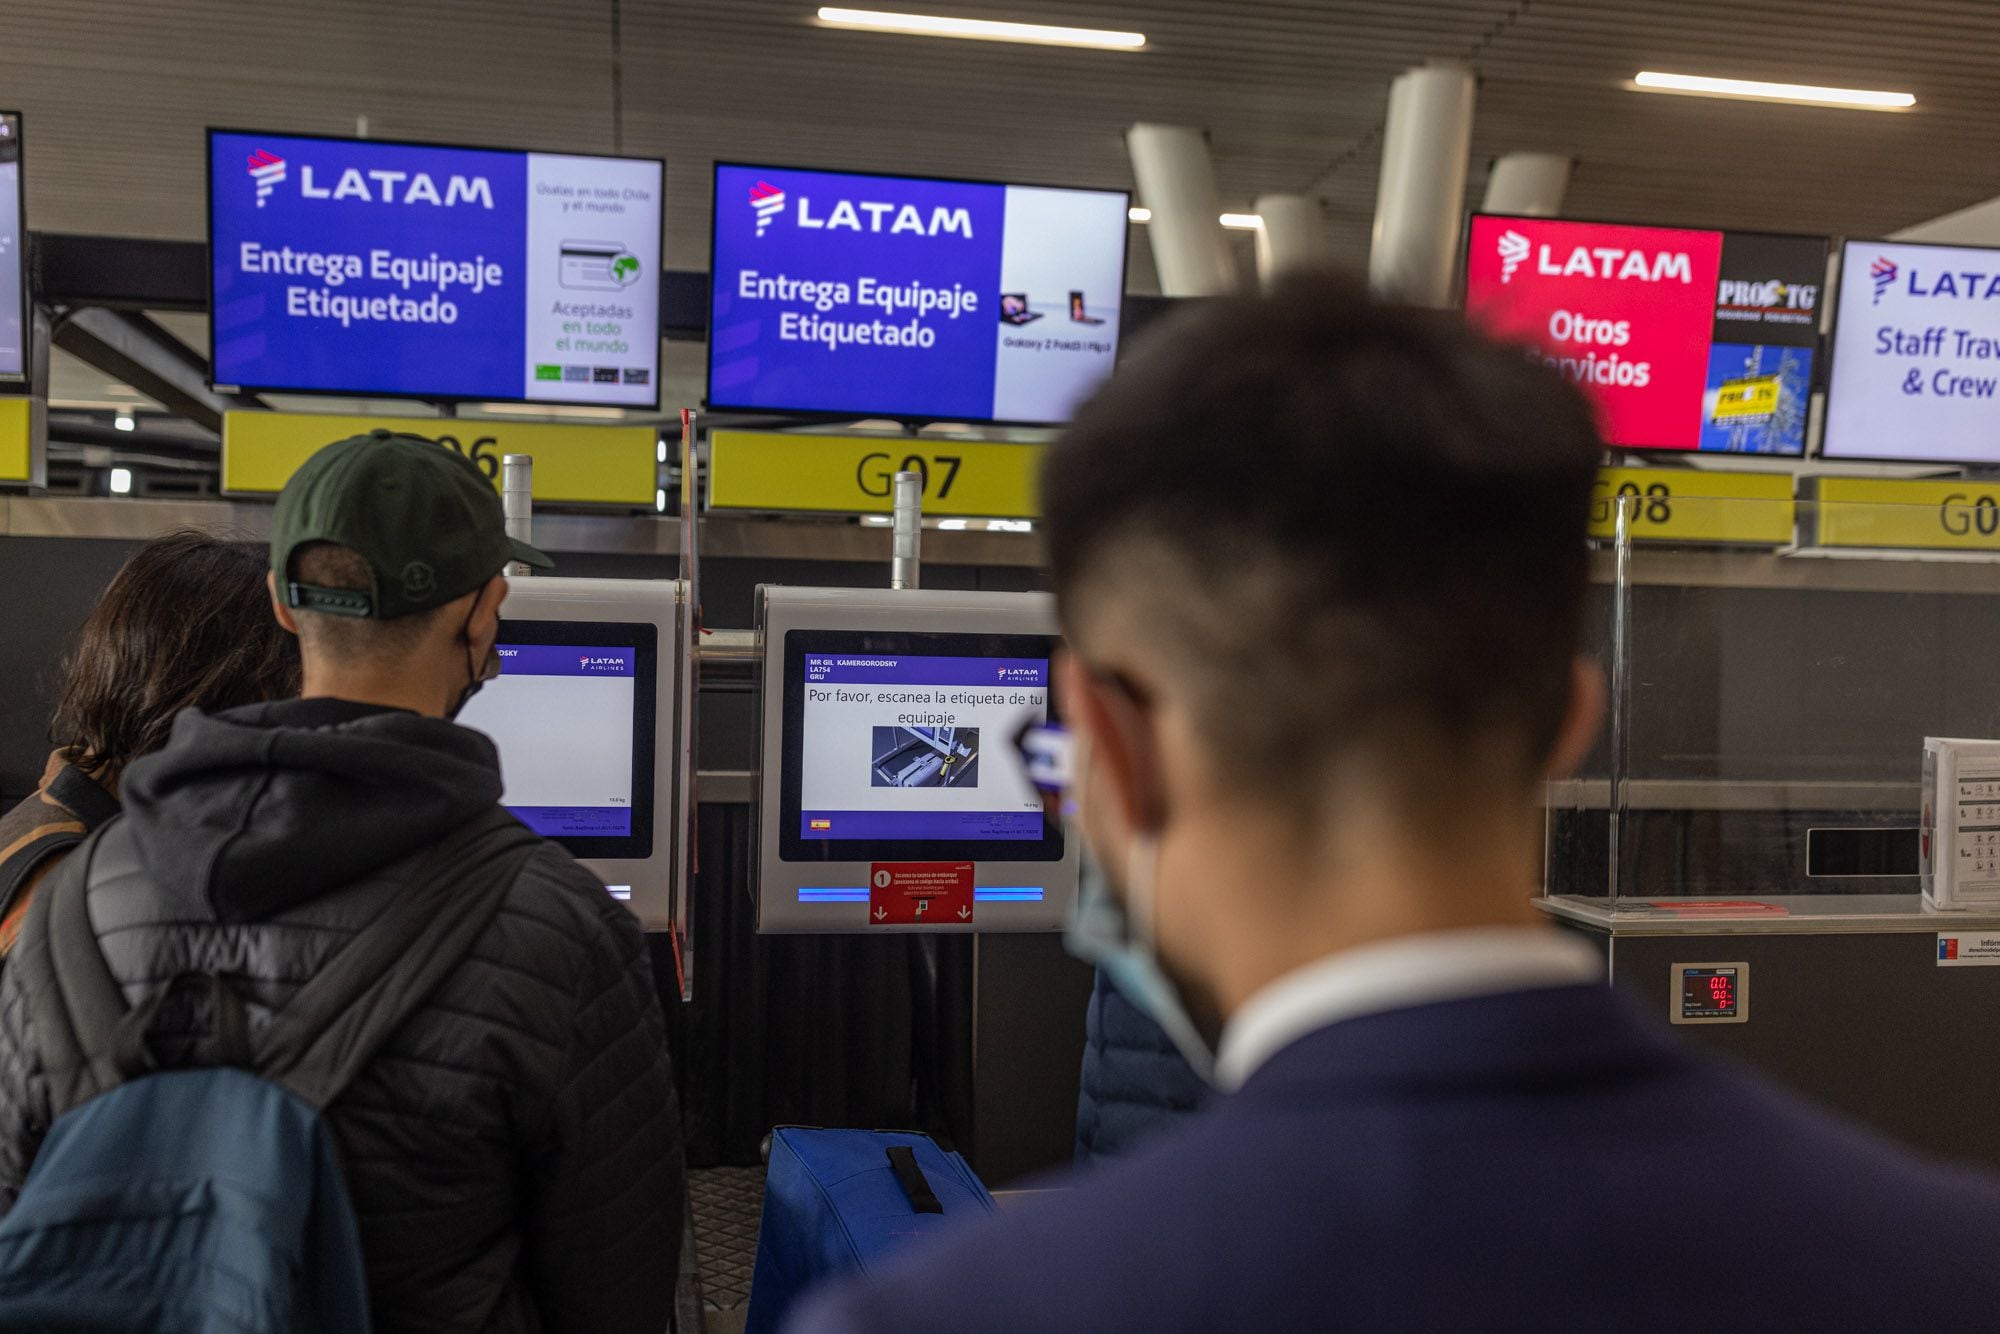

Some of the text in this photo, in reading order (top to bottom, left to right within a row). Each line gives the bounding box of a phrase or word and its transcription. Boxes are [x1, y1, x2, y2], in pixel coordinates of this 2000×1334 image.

[301, 165, 494, 209] LATAM
[797, 197, 973, 239] LATAM
[240, 242, 502, 294] Entrega Equipaje
[1537, 244, 1692, 284] LATAM
[287, 286, 458, 328] Etiquetado
[552, 301, 634, 319] Aceptadas
[738, 270, 978, 319] Entrega Equipaje
[556, 338, 629, 354] el mundo
[562, 322, 622, 336] en todo
[779, 312, 936, 350] Etiquetado
[1549, 309, 1631, 346] Otros
[1875, 326, 1947, 357] Staff
[1534, 350, 1651, 387] rvicios
[1902, 368, 1997, 397] & Crew
[856, 453, 962, 499] G07
[809, 689, 1043, 707] Por favor, escanea la etiqueta de tu
[898, 711, 956, 727] equipaje
